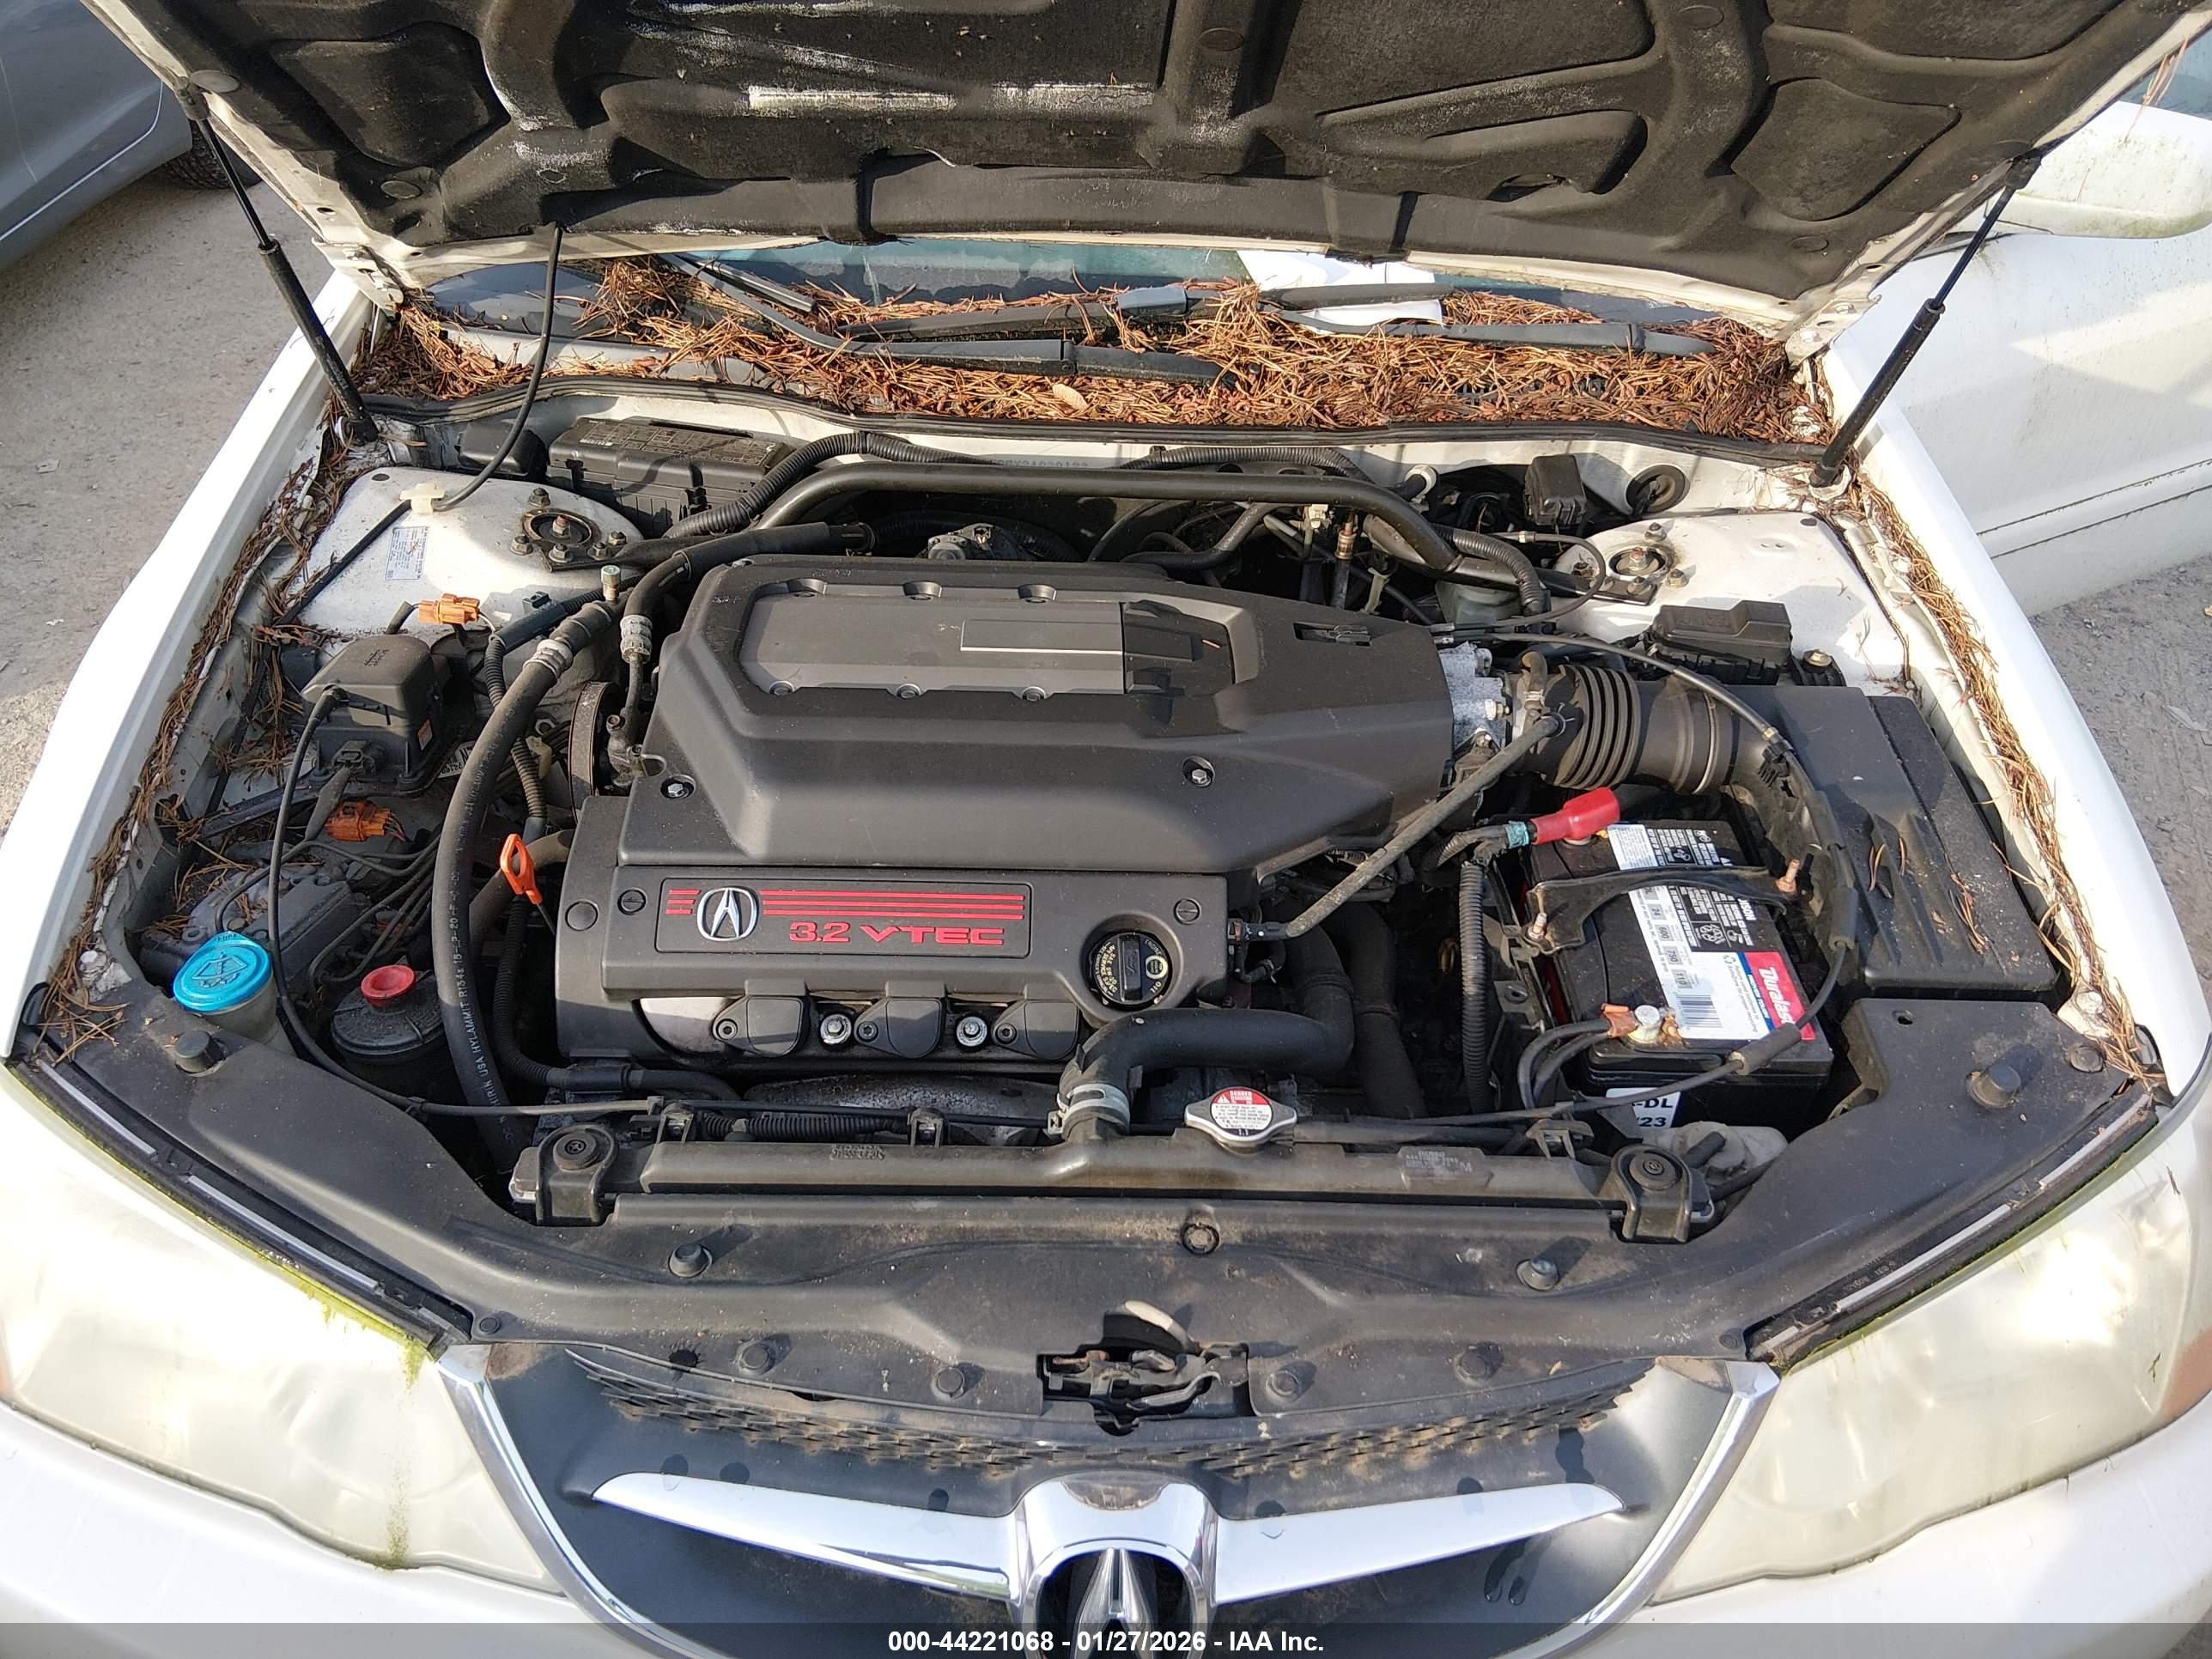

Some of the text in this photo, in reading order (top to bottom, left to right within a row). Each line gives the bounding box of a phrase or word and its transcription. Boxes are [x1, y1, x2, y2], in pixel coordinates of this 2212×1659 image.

[790, 922, 1004, 945] 3.2 VTEC
[1100, 952, 1109, 976] SERVICE
[1658, 927, 1670, 938] 600
[1666, 950, 1678, 962] 750
[1674, 972, 1687, 985] 110
[1150, 981, 1162, 993] OIL
[1757, 966, 1795, 1023] Duralast
[475, 1056, 489, 1076] USA
